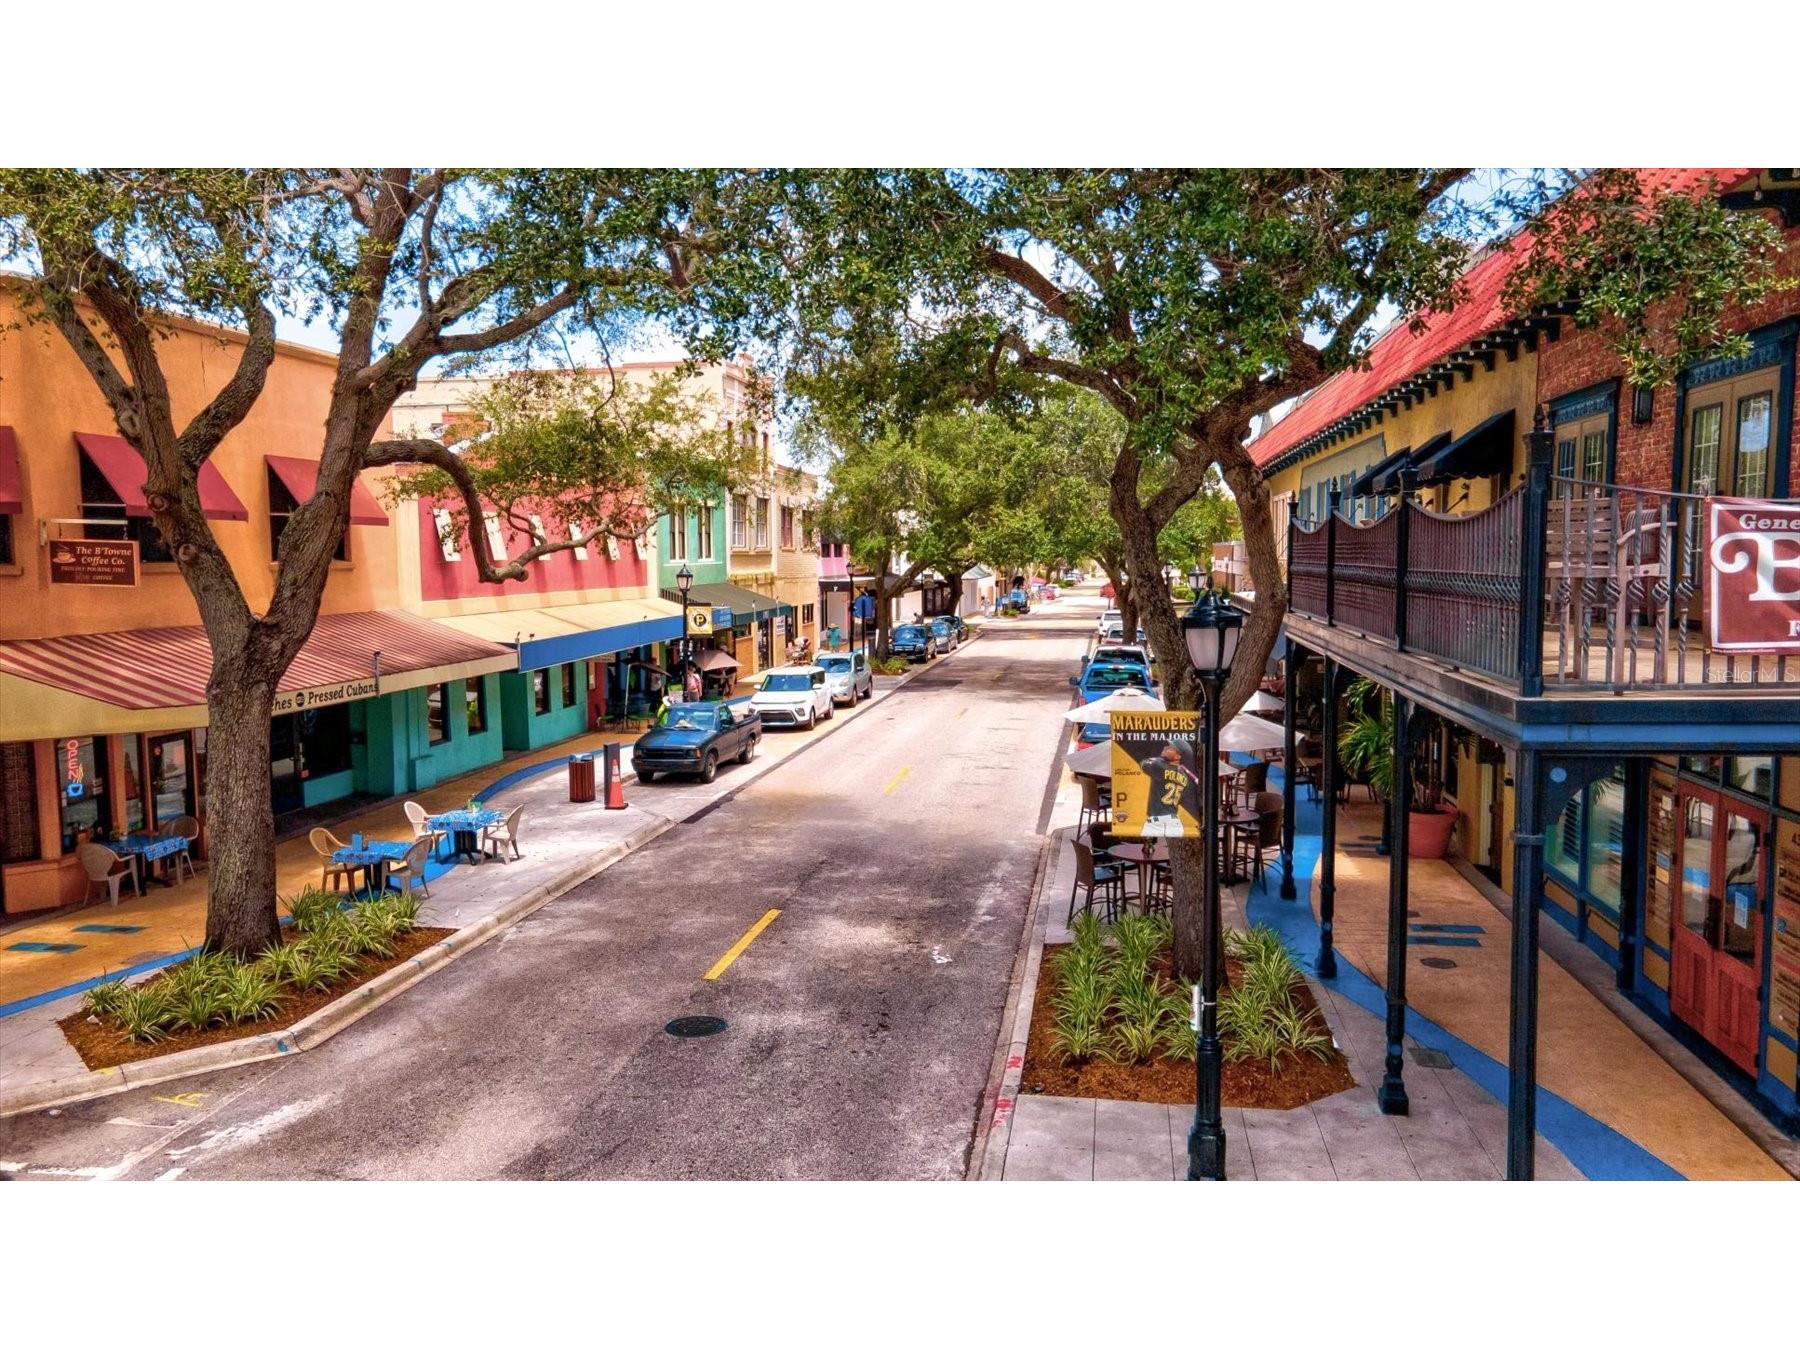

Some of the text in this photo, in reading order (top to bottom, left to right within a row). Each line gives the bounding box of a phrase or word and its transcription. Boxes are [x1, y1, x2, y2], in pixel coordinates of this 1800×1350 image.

[1739, 513, 1800, 530] Gene
[76, 546, 132, 556] The B'Towne
[81, 556, 126, 566] Coffee Co.
[696, 615, 704, 626] P
[308, 687, 344, 705] Pressed
[346, 682, 379, 697] Cubans
[1112, 715, 1196, 731] MARAUDERS
[1112, 732, 1196, 741] IN THE MAJORS
[67, 740, 78, 780] OPEN
[1116, 792, 1127, 808] P
